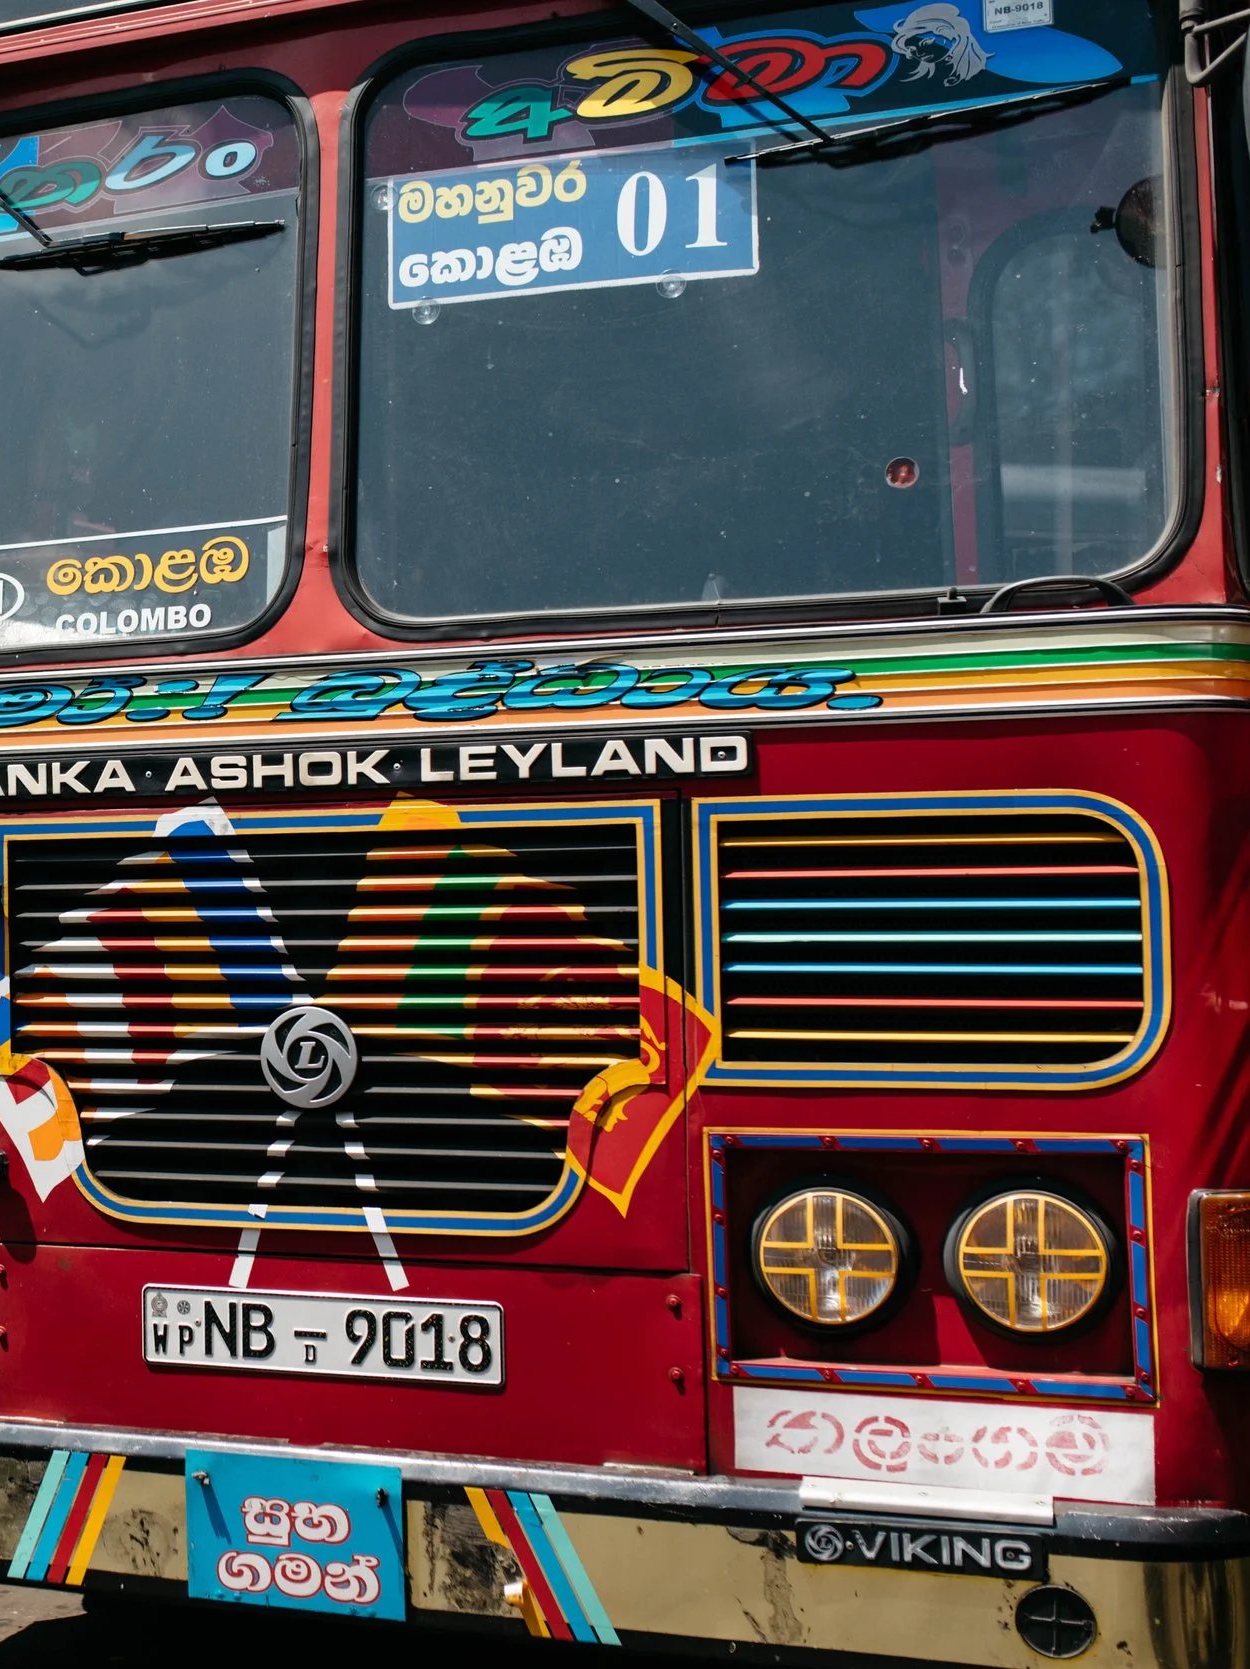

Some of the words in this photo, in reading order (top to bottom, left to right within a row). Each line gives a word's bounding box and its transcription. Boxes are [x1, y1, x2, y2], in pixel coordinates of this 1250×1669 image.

[994, 1, 1044, 16] NB-9018
[398, 160, 587, 225] මහනුවර
[616, 163, 728, 257] 01
[399, 226, 583, 288] කොළඹ
[46, 535, 250, 596] කොළඹ
[55, 603, 212, 636] COLOMBO
[163, 749, 391, 793] ASHOK
[420, 735, 749, 783] LEYLAND
[345, 1308, 492, 1373] 9018
[217, 1550, 381, 1606] ගමන්
[851, 1529, 1033, 1571] VIKING
